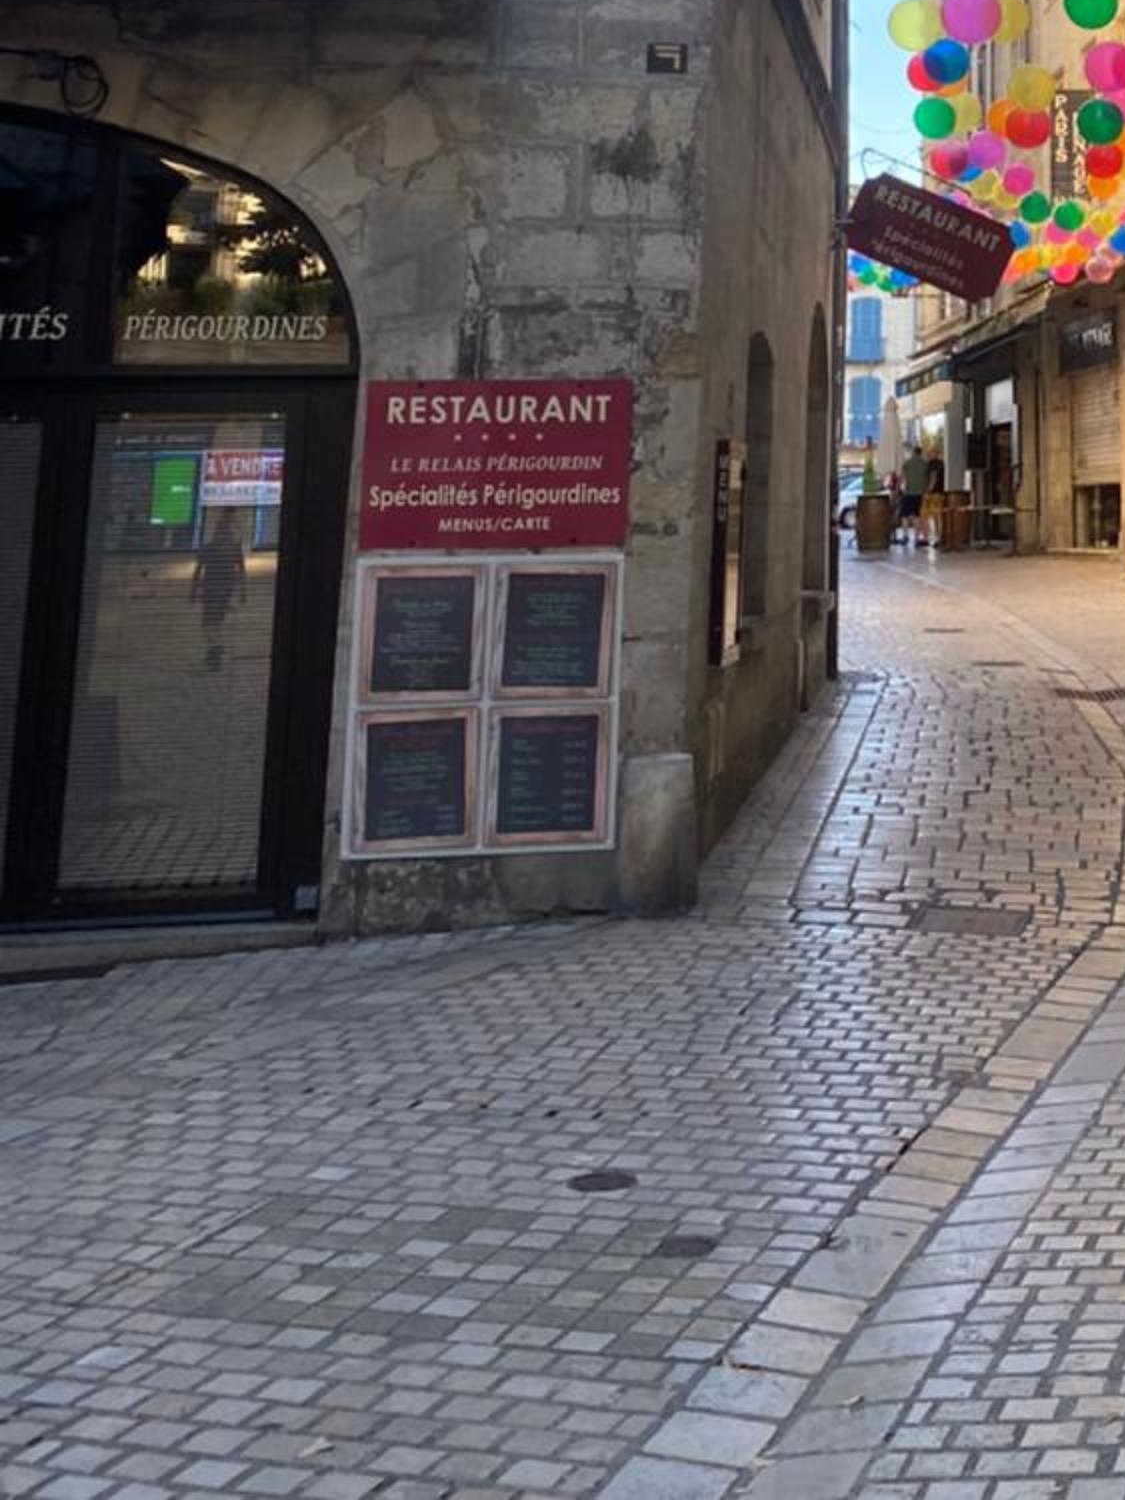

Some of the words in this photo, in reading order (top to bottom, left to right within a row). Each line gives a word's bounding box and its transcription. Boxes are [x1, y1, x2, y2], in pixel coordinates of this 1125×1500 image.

[1055, 93, 1069, 163] PARIS
[874, 184, 1001, 252] RESTAURANT
[124, 309, 327, 341] PÉRIGOURDINES
[386, 395, 612, 424] RESTAURANT
[390, 457, 412, 473] LE
[418, 456, 482, 472] RELAIS
[486, 453, 604, 472] PÉRIGOURDIN
[369, 481, 478, 512] Spécialités
[483, 480, 621, 510] Périgourdines
[437, 516, 551, 532] MENUS/CARTE
